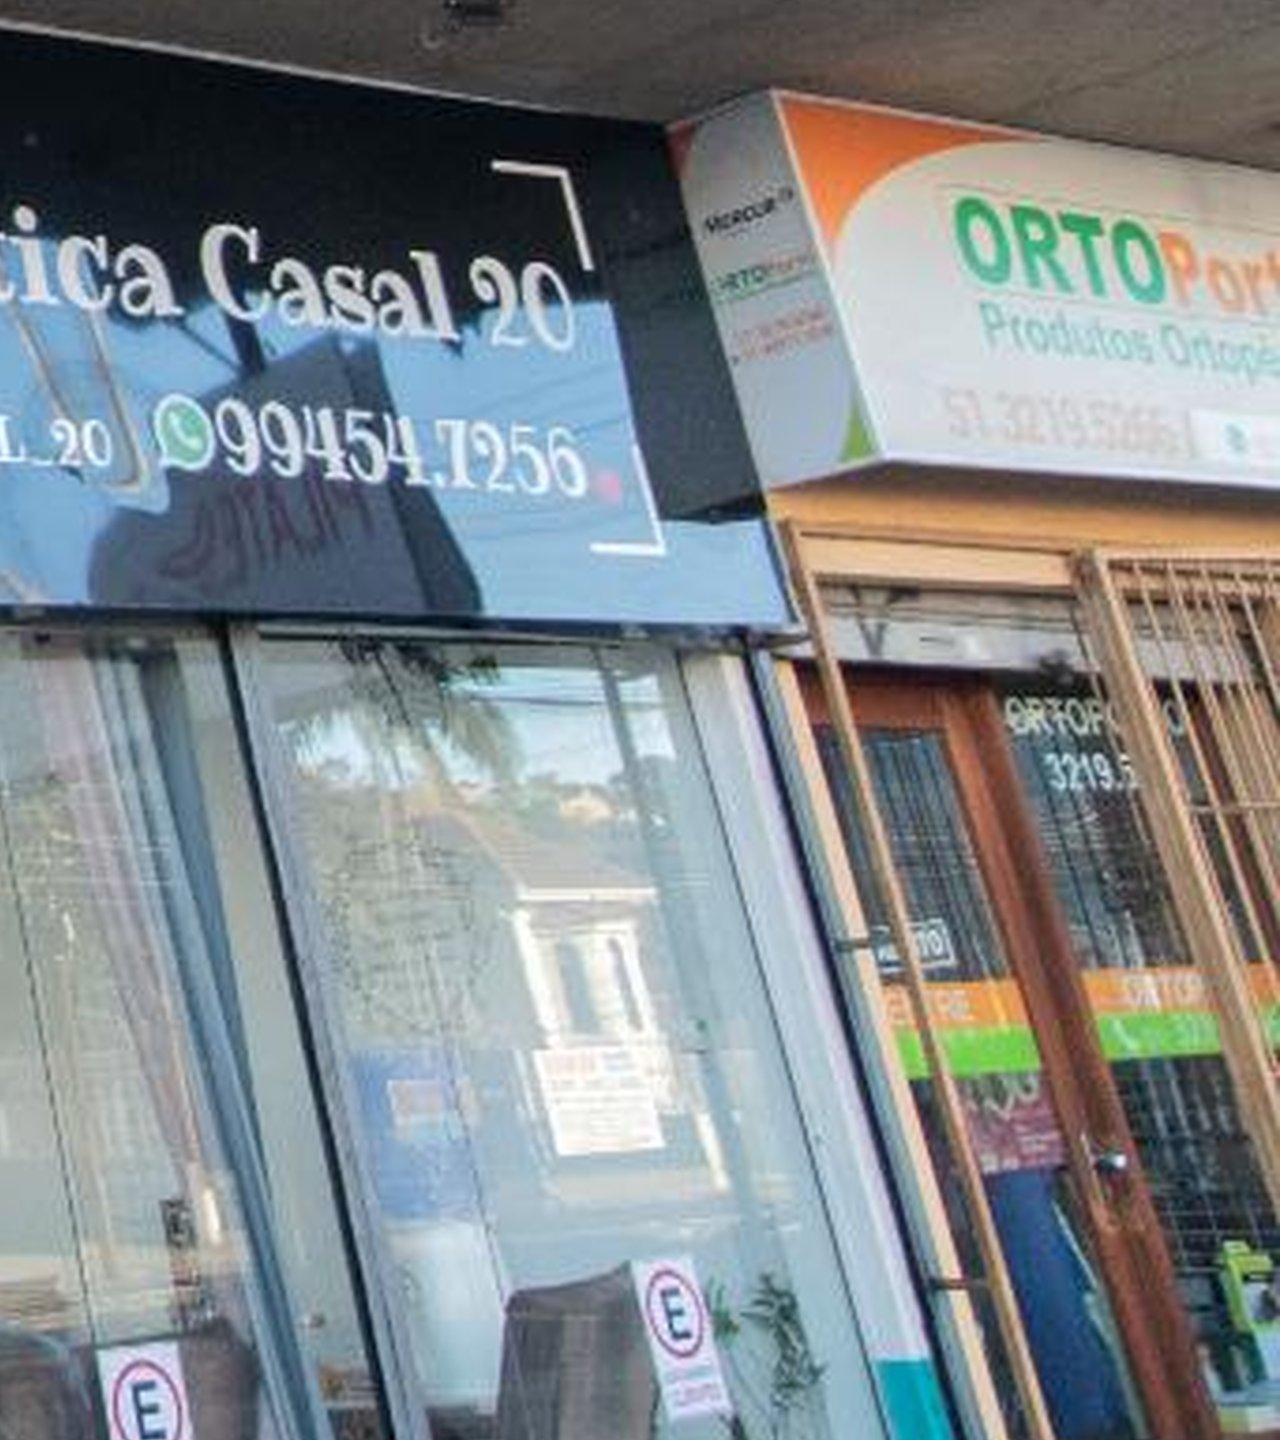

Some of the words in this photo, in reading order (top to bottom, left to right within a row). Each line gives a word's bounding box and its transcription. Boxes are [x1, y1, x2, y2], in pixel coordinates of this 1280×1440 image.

[203, 224, 458, 349] Casal
[467, 256, 575, 352] 20
[980, 301, 1154, 364] Produtos
[212, 398, 587, 499] 99454.7256
[660, 1287, 693, 1341] E
[132, 1380, 167, 1440] E
